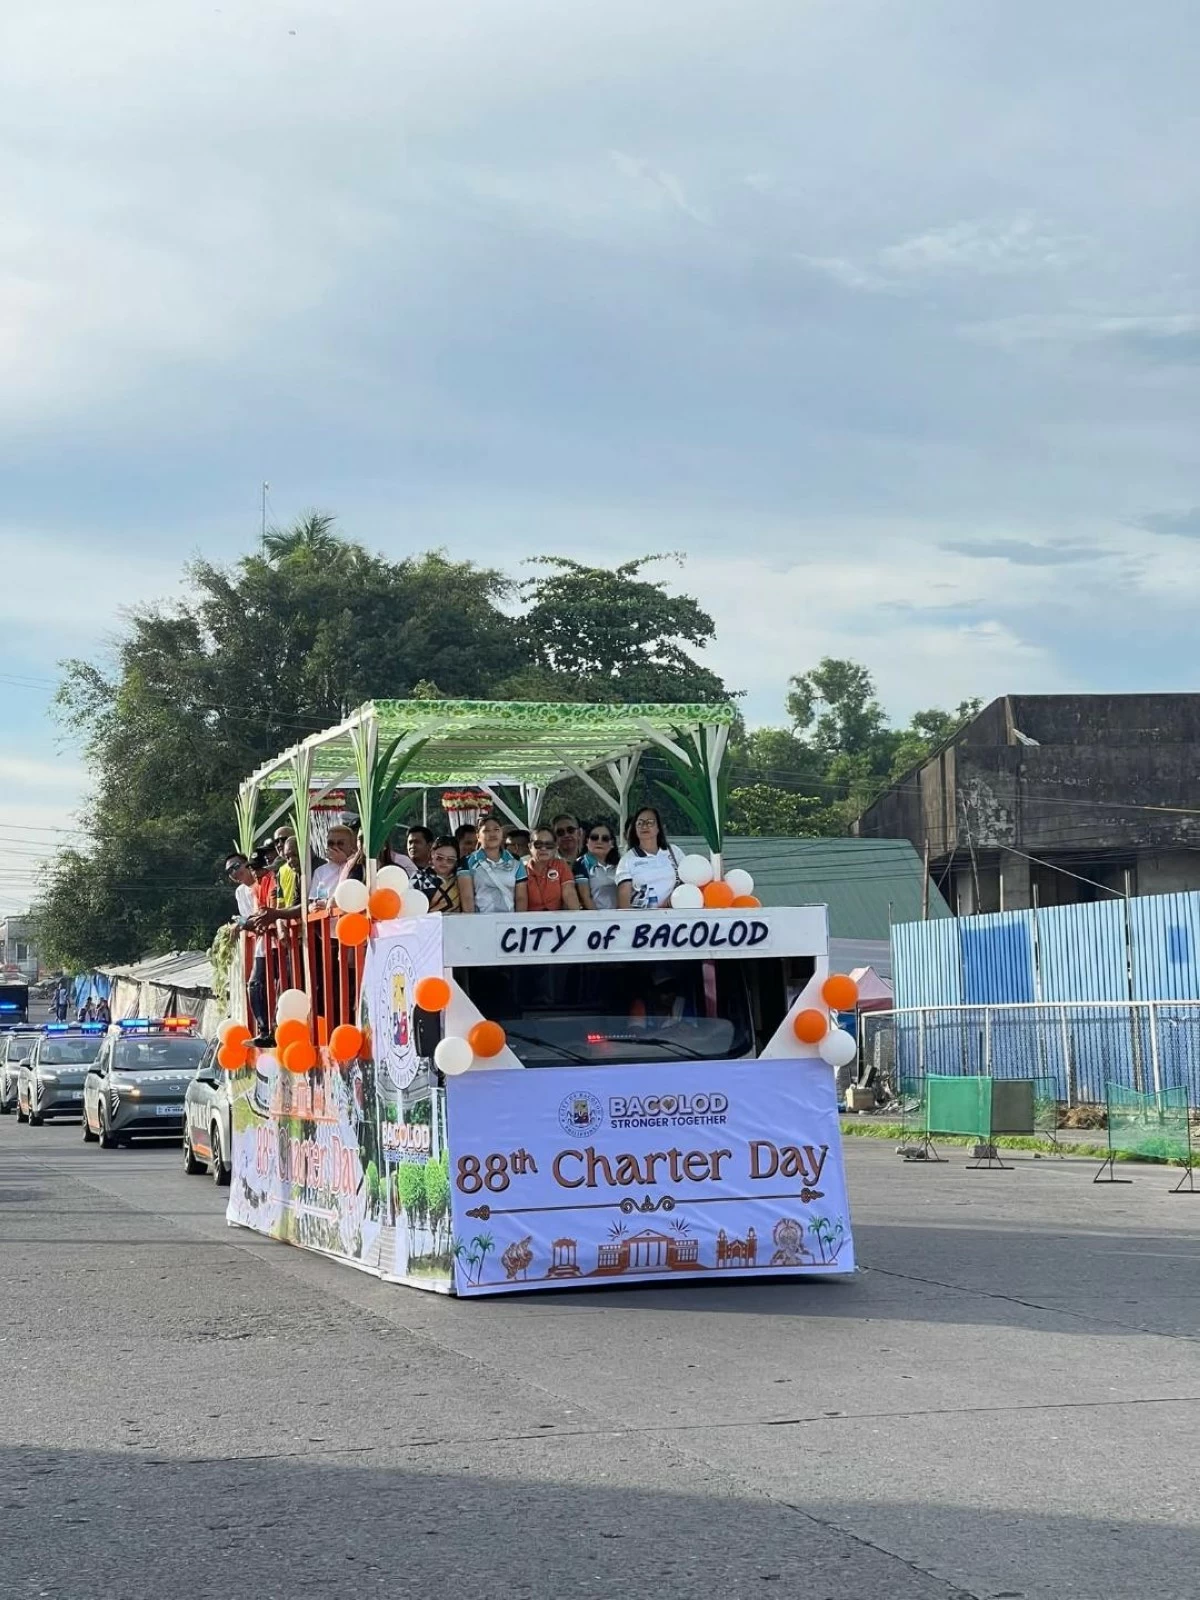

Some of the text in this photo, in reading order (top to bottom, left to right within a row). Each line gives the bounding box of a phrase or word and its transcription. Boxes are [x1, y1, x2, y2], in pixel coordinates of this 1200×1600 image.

[500, 920, 769, 953] CITY of BACOLOD
[609, 1092, 729, 1118] BACOLOD
[382, 1121, 430, 1152] BACOLOD
[611, 1114, 727, 1129] STRONGER TOGETHER
[455, 1140, 829, 1194] 88th Charter Day
